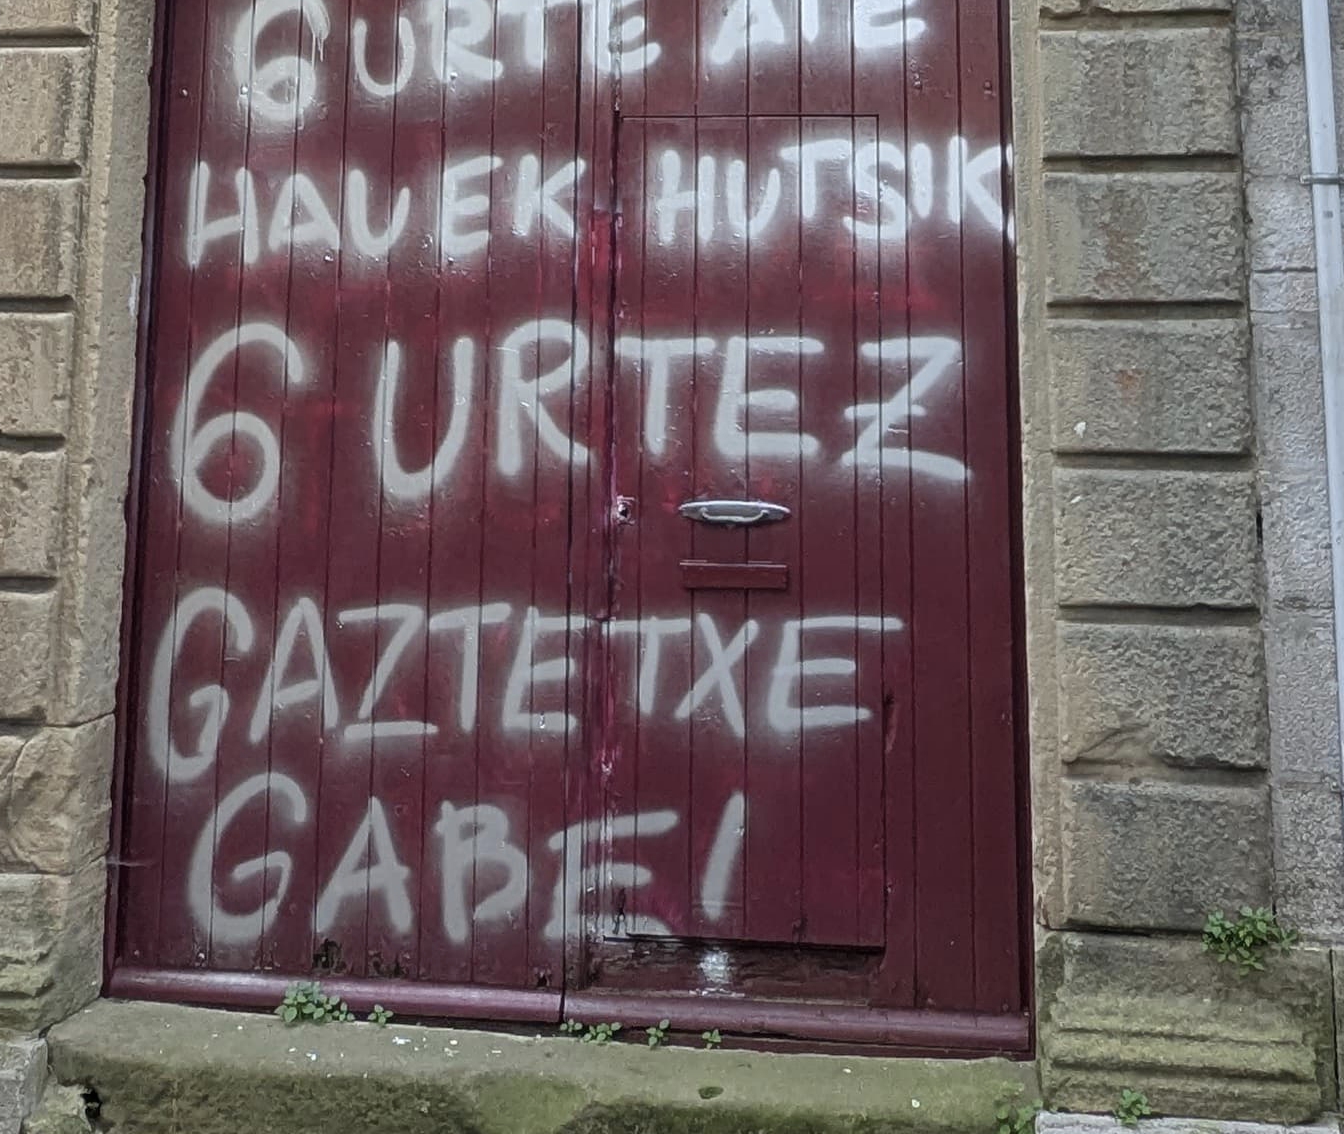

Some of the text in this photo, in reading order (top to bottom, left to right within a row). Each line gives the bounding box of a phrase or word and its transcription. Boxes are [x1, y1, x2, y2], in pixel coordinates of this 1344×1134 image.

[187, 134, 1015, 268] HAUEK HUTSIK
[174, 319, 972, 524] 6 URTEZ
[148, 586, 904, 780] GAZTETXE
